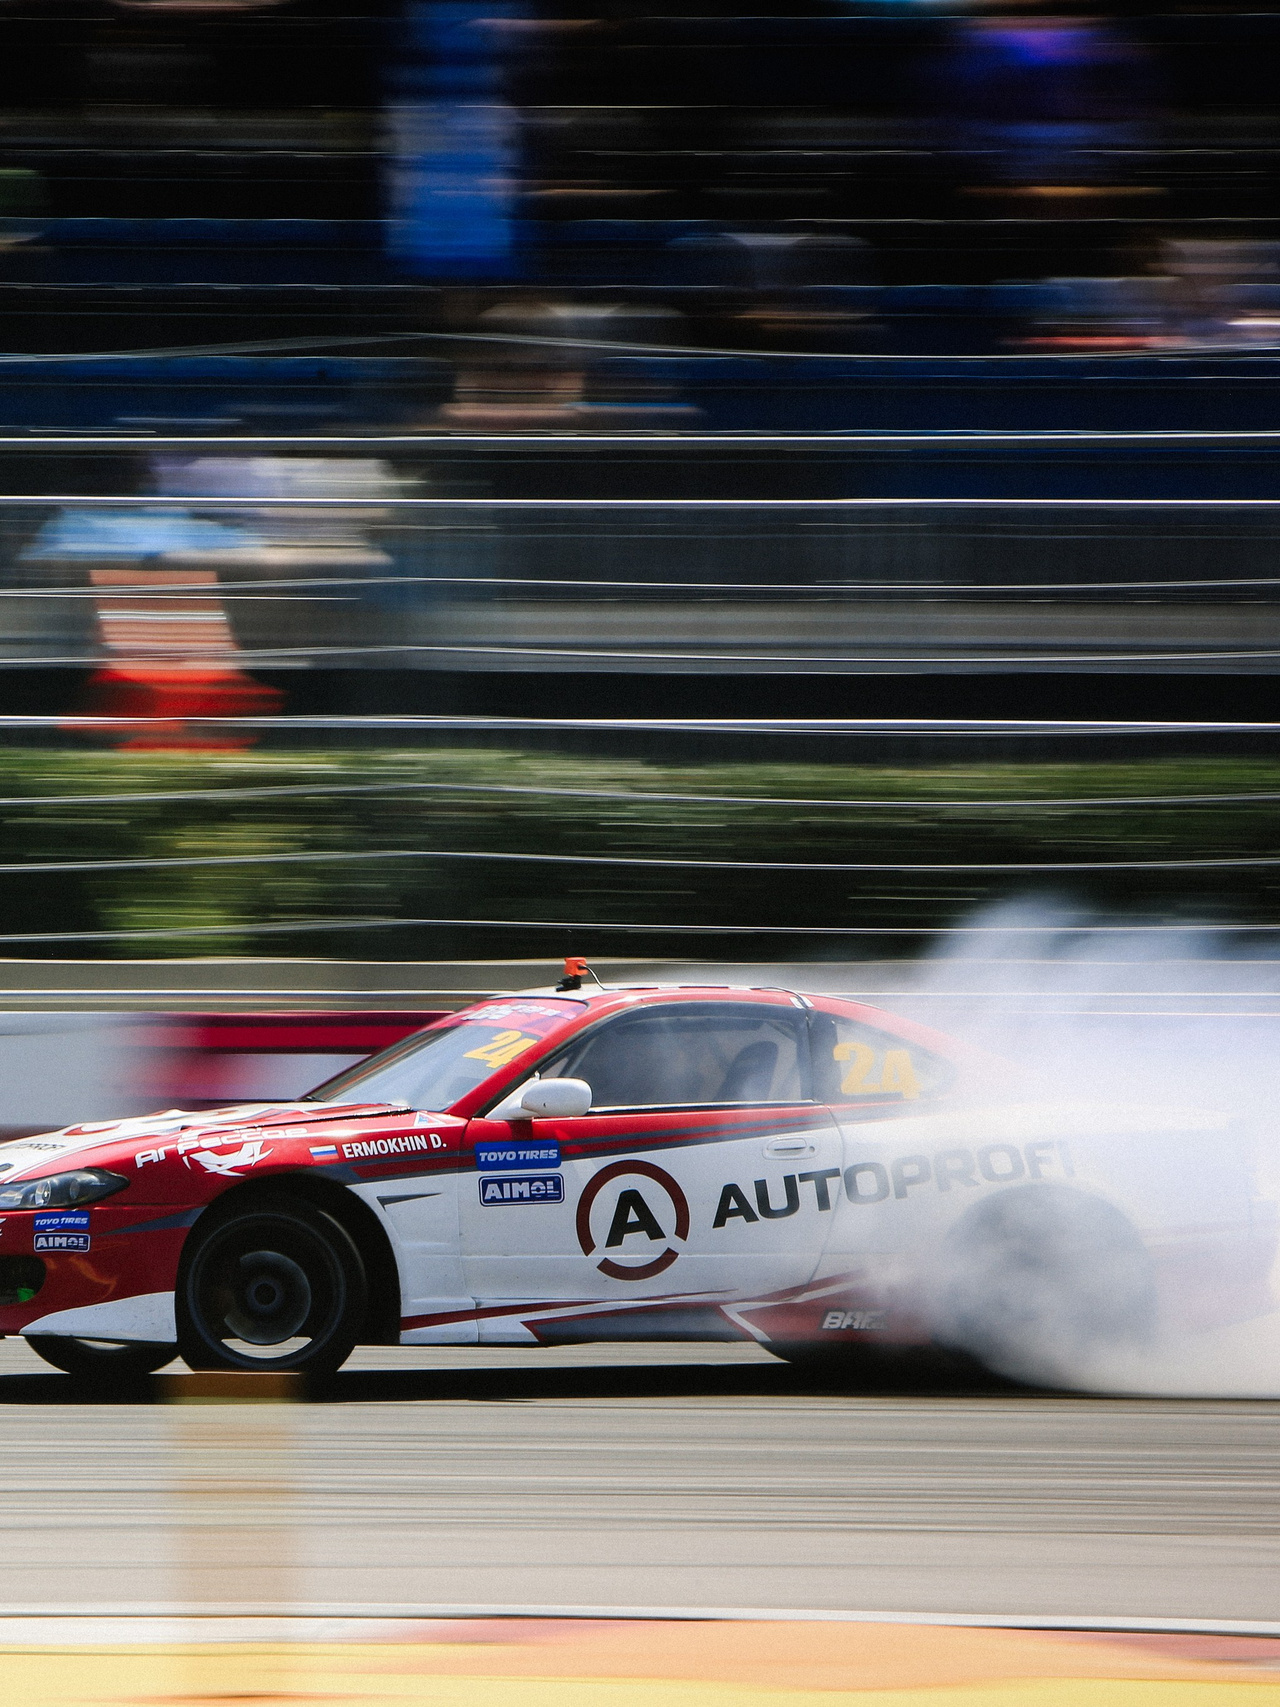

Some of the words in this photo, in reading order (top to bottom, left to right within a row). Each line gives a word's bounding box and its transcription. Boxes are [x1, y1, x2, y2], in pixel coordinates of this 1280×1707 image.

[462, 1030, 538, 1069] 24
[832, 1042, 923, 1100] 24
[341, 1134, 427, 1159] ERMOKHIN
[428, 1133, 448, 1150] D.
[478, 1151, 516, 1162] TOYO
[518, 1149, 558, 1160] TIRES
[484, 1180, 561, 1201] AIMOL
[711, 1139, 1076, 1230] AUTOPROFI
[34, 1218, 60, 1227] TOYO
[60, 1217, 89, 1225] TIRES
[36, 1236, 88, 1248] AIMOL
